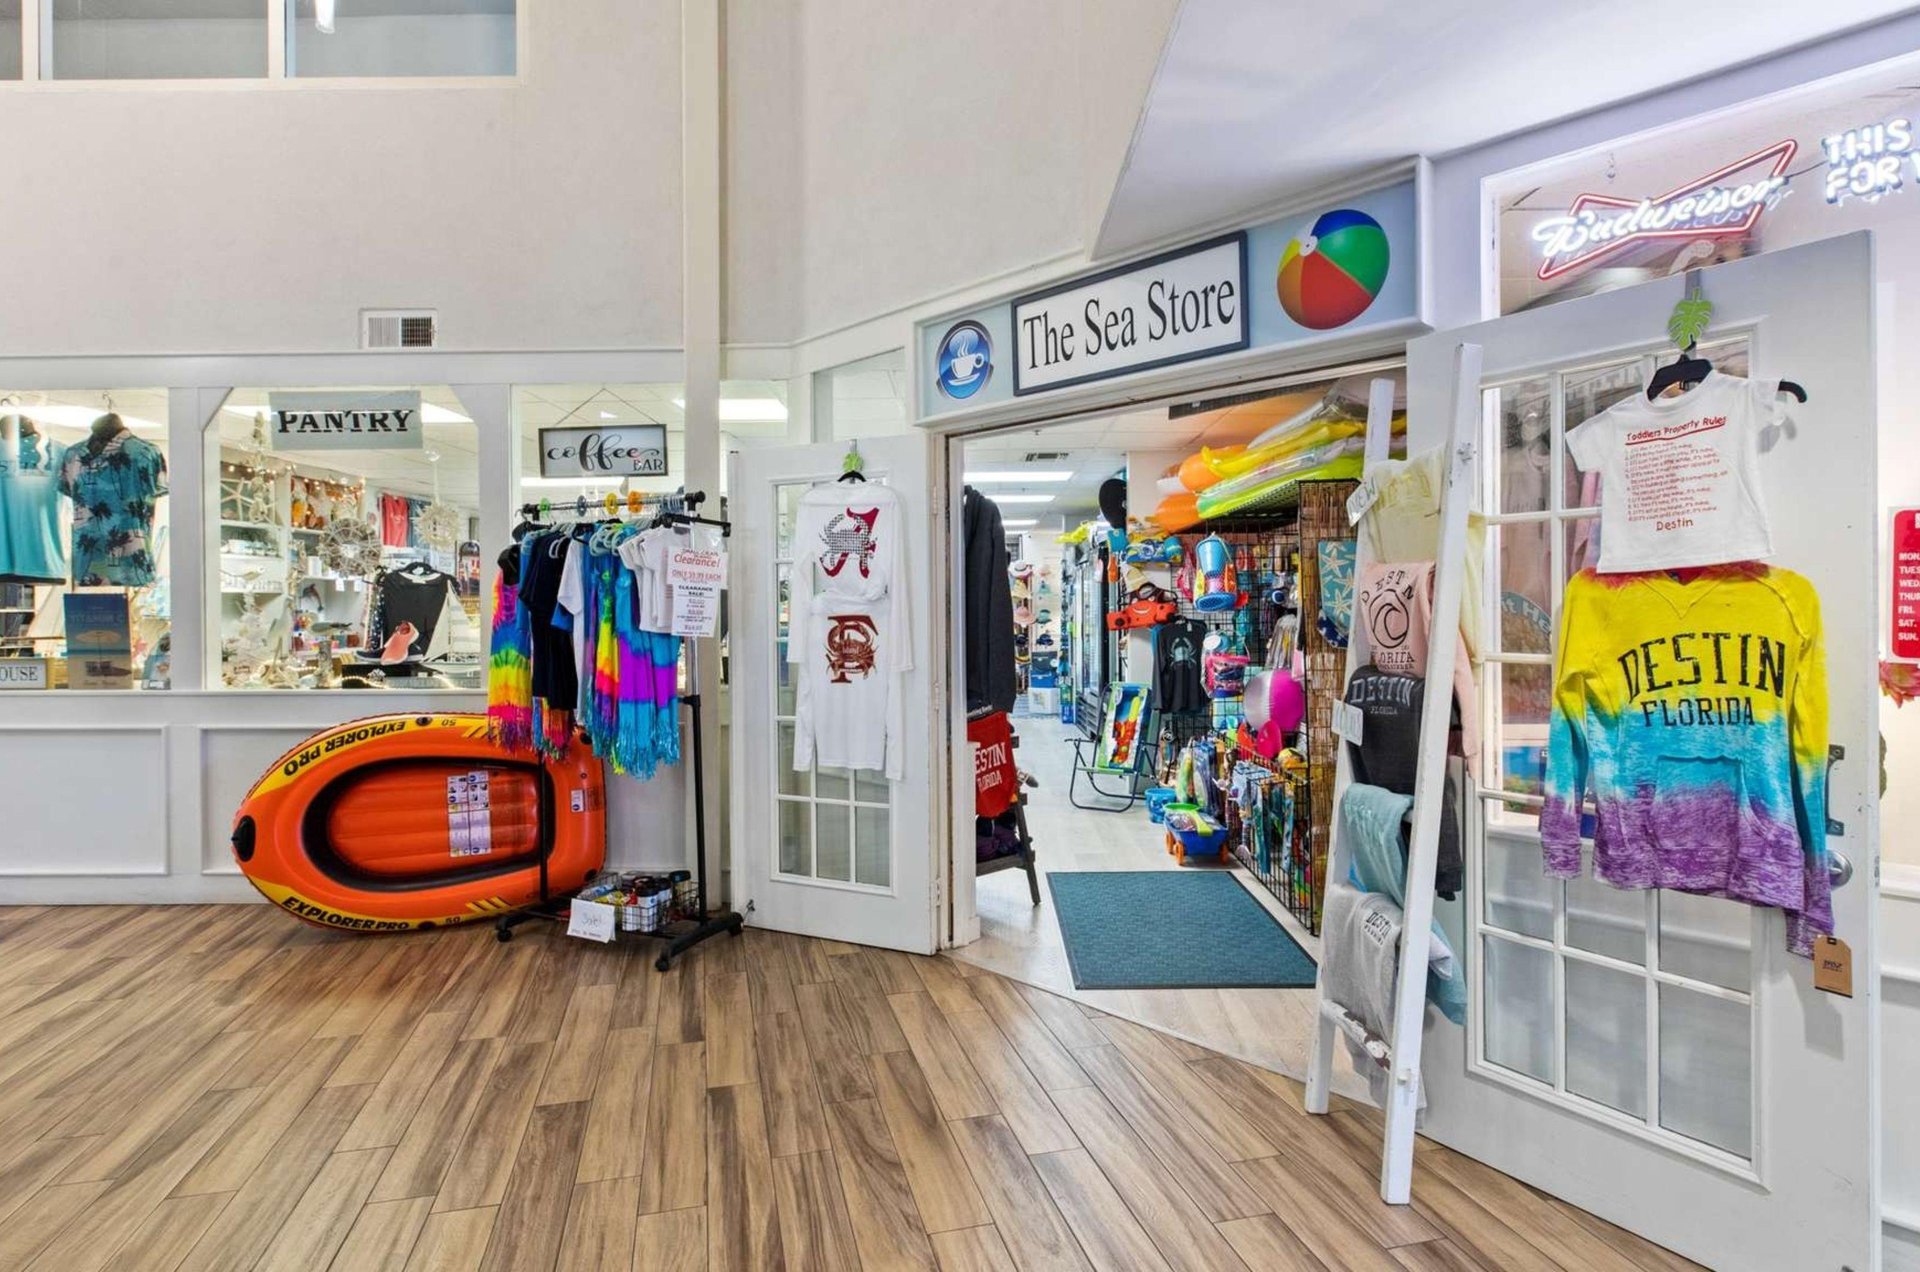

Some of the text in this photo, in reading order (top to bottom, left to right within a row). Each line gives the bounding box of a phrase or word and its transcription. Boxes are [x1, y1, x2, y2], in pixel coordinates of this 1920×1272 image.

[1821, 119, 1911, 167] THIS
[1826, 156, 1903, 204] FOR
[1532, 177, 1786, 257] Budweiser
[1023, 279, 1235, 369] The Sea Store
[278, 410, 414, 433] PANTRY
[1626, 430, 1661, 441] Toddlers
[1664, 420, 1700, 434] Property
[547, 433, 660, 472] coffee
[633, 458, 663, 471] BAR
[1655, 518, 1694, 532] Destin
[1618, 632, 1785, 704] DESTIN
[1350, 676, 1415, 707] DESTIN
[1641, 697, 1755, 727] FLORIDA
[284, 721, 406, 776] EXPLORER PRO
[282, 896, 410, 930] EXPLORER PRO
